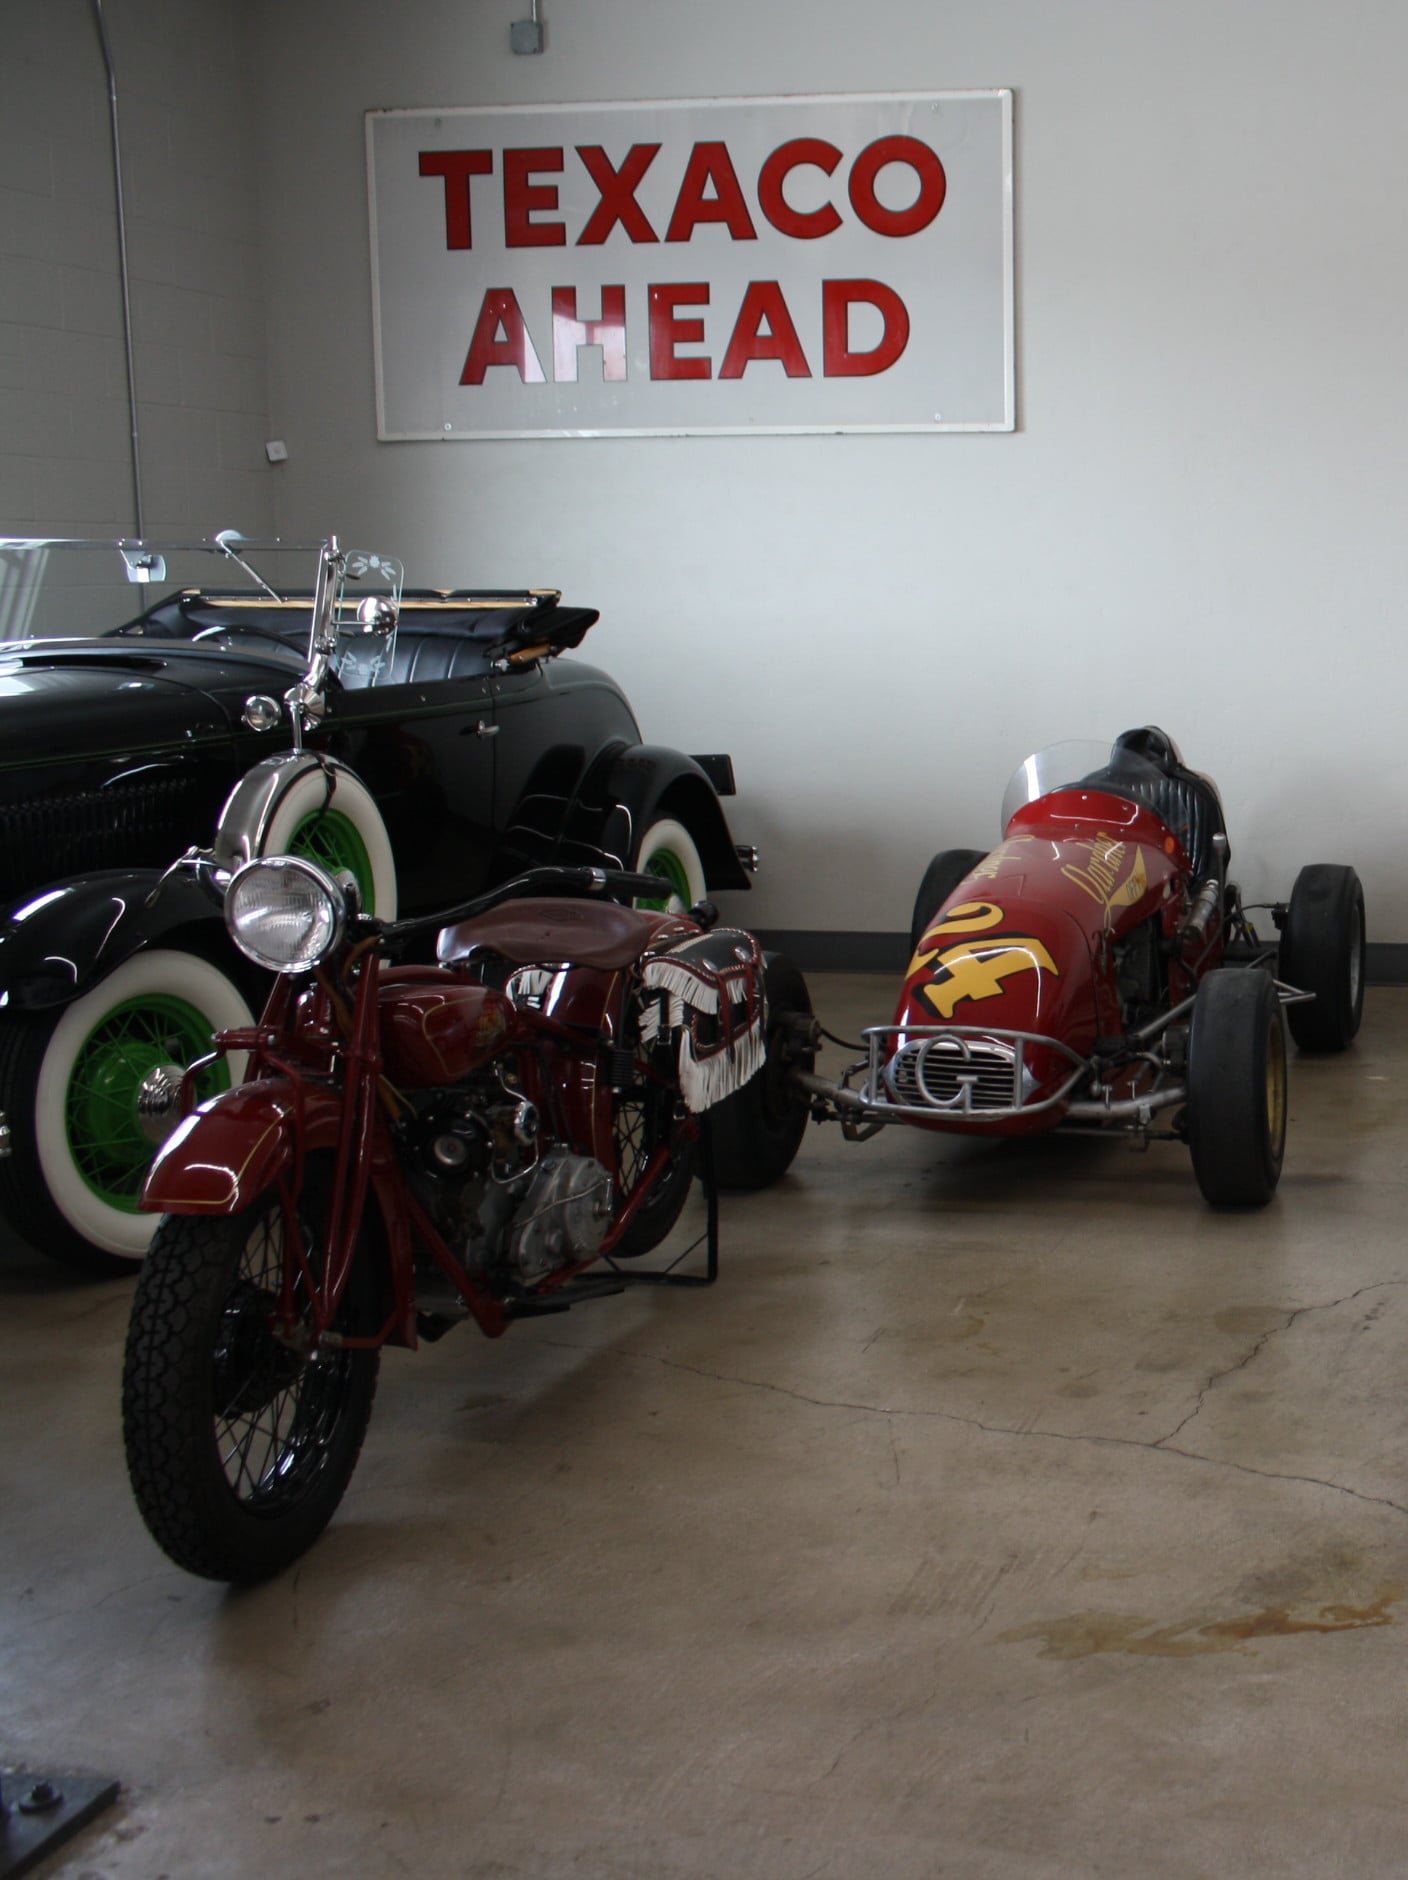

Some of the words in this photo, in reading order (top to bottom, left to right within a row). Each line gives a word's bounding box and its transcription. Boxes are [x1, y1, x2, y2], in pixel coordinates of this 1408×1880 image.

[418, 134, 947, 250] TEXACO
[458, 278, 911, 386] AHEAD
[904, 901, 1059, 1019] 24
